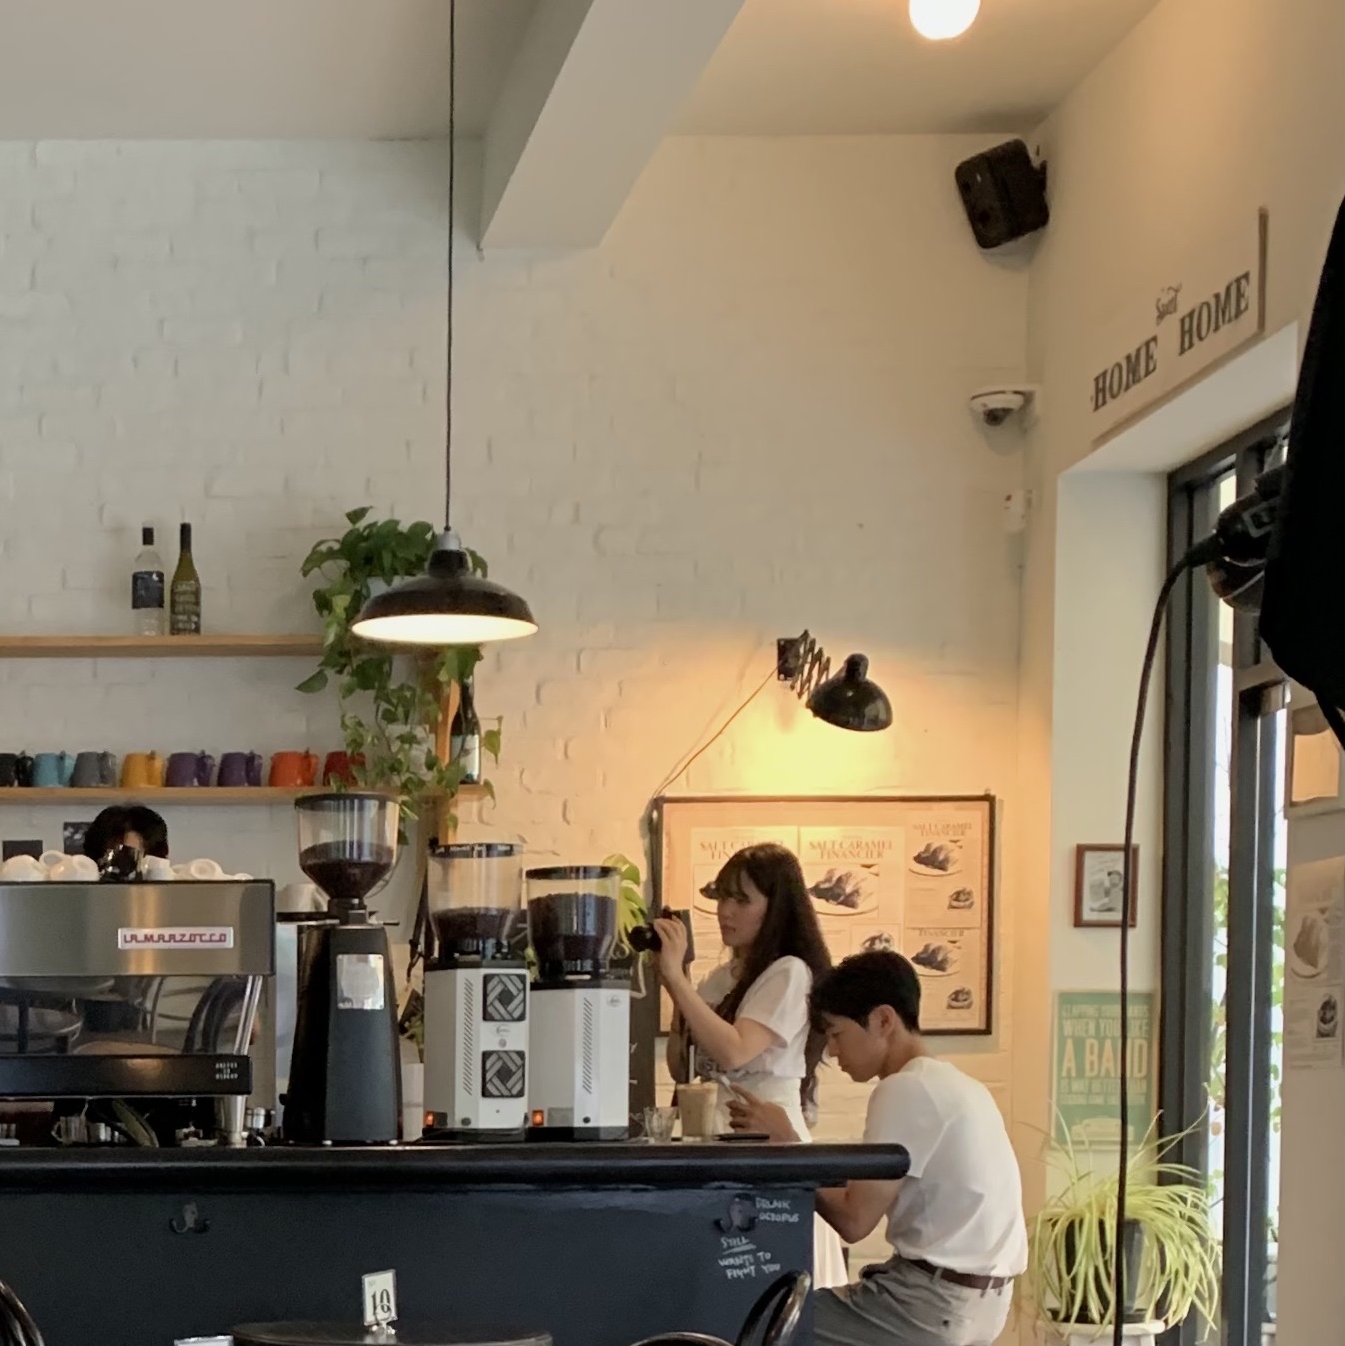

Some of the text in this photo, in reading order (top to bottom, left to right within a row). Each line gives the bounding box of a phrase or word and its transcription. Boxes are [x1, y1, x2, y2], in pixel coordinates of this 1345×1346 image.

[1093, 335, 1158, 412] HOME
[1178, 270, 1250, 356] HOME
[124, 934, 138, 943] LA
[1063, 1019, 1096, 1037] WHEN
[1061, 1038, 1077, 1077] A
[757, 1251, 772, 1262] TO
[761, 1263, 781, 1274] YOU
[371, 1289, 391, 1316] 10
